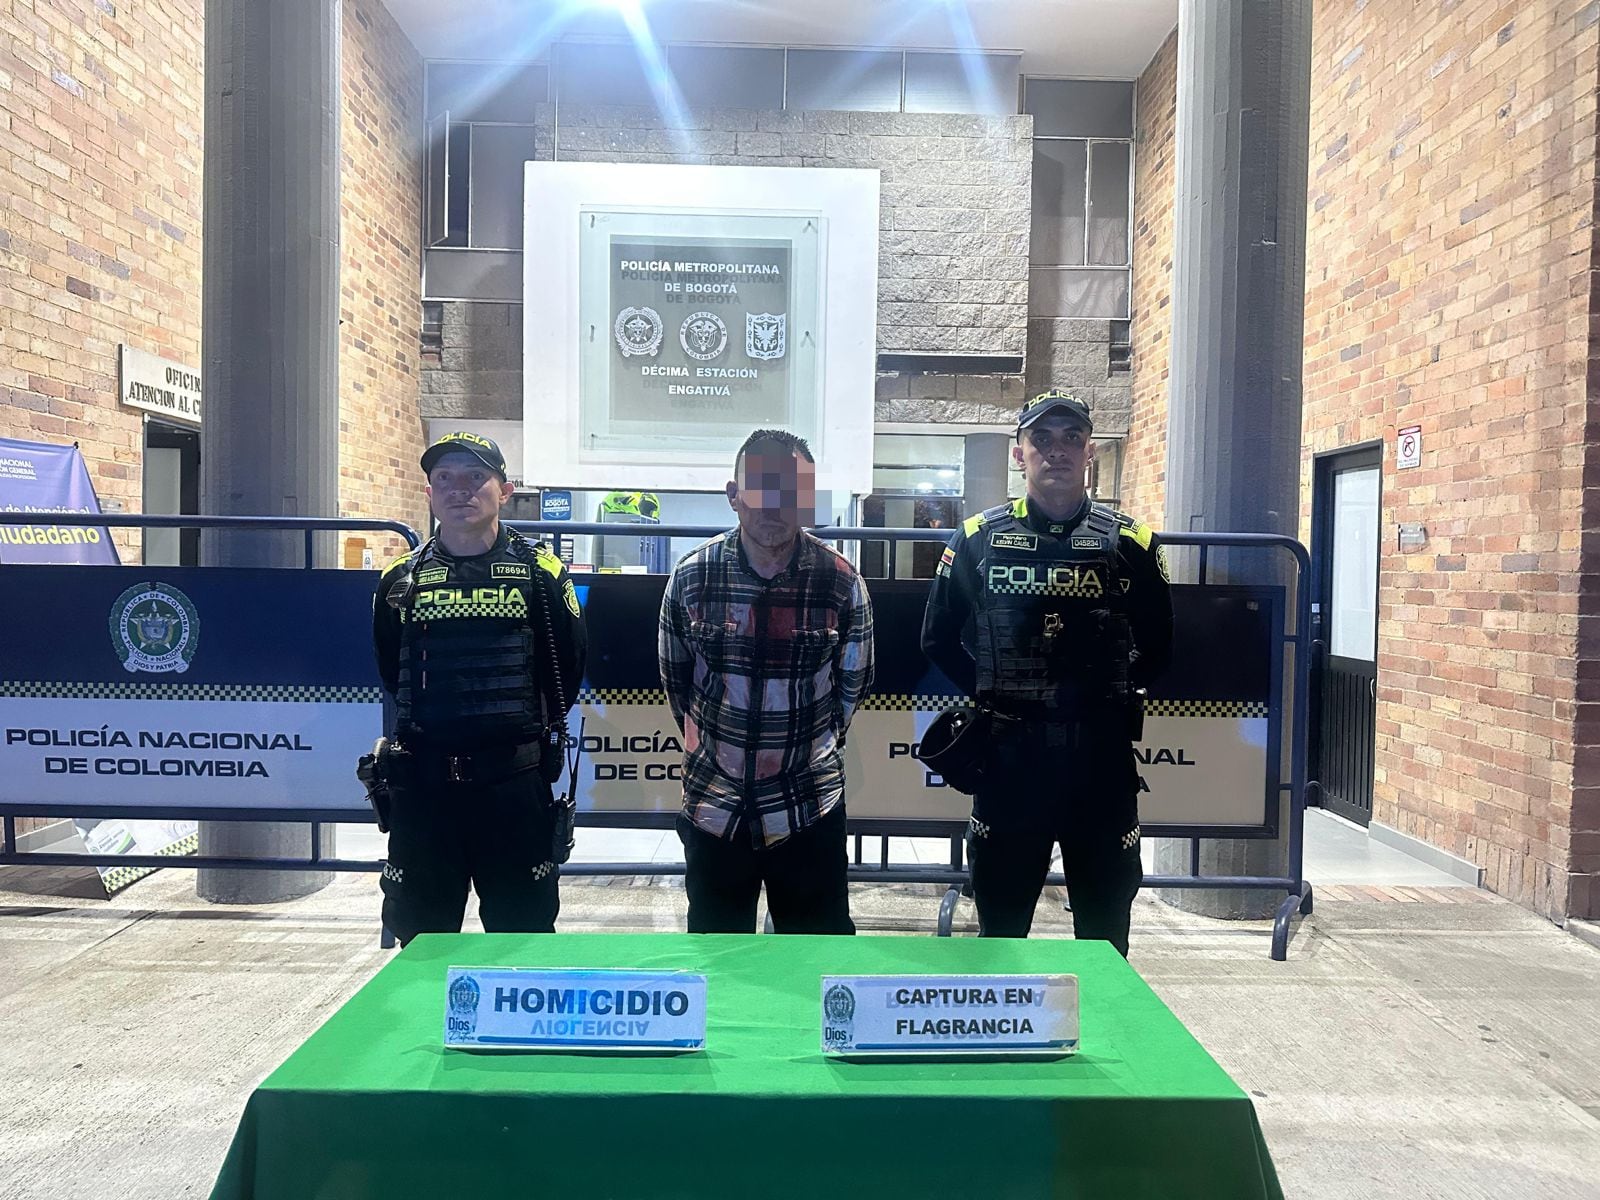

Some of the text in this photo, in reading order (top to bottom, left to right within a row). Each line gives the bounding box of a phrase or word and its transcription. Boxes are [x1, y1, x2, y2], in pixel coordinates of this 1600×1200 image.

[620, 260, 780, 274] POLICÍA METROPOLITANA
[664, 283, 738, 294] DE BOGOTÁ
[641, 365, 758, 378] DÉCIMA ESTACIÓN
[129, 381, 175, 408] ATENCION
[178, 395, 190, 413] AL
[668, 385, 731, 396] ENGATIVÁ
[988, 565, 1103, 590] POLICÍA
[415, 584, 526, 608] POLICÍA
[121, 597, 143, 633] REPUBLICA
[166, 597, 189, 633] COLOMBIA
[6, 724, 312, 751] POLICÍA NACIONAL
[45, 757, 269, 778] DE COLOMBIA
[594, 764, 638, 780] DE
[494, 987, 690, 1017] HOMICIDIO
[896, 988, 998, 1005] CAPTURA
[1005, 989, 1033, 1004] EN
[448, 1017, 470, 1031] Dios
[896, 1019, 1034, 1035] FLAGRANCIA
[825, 1027, 847, 1040] Dios
